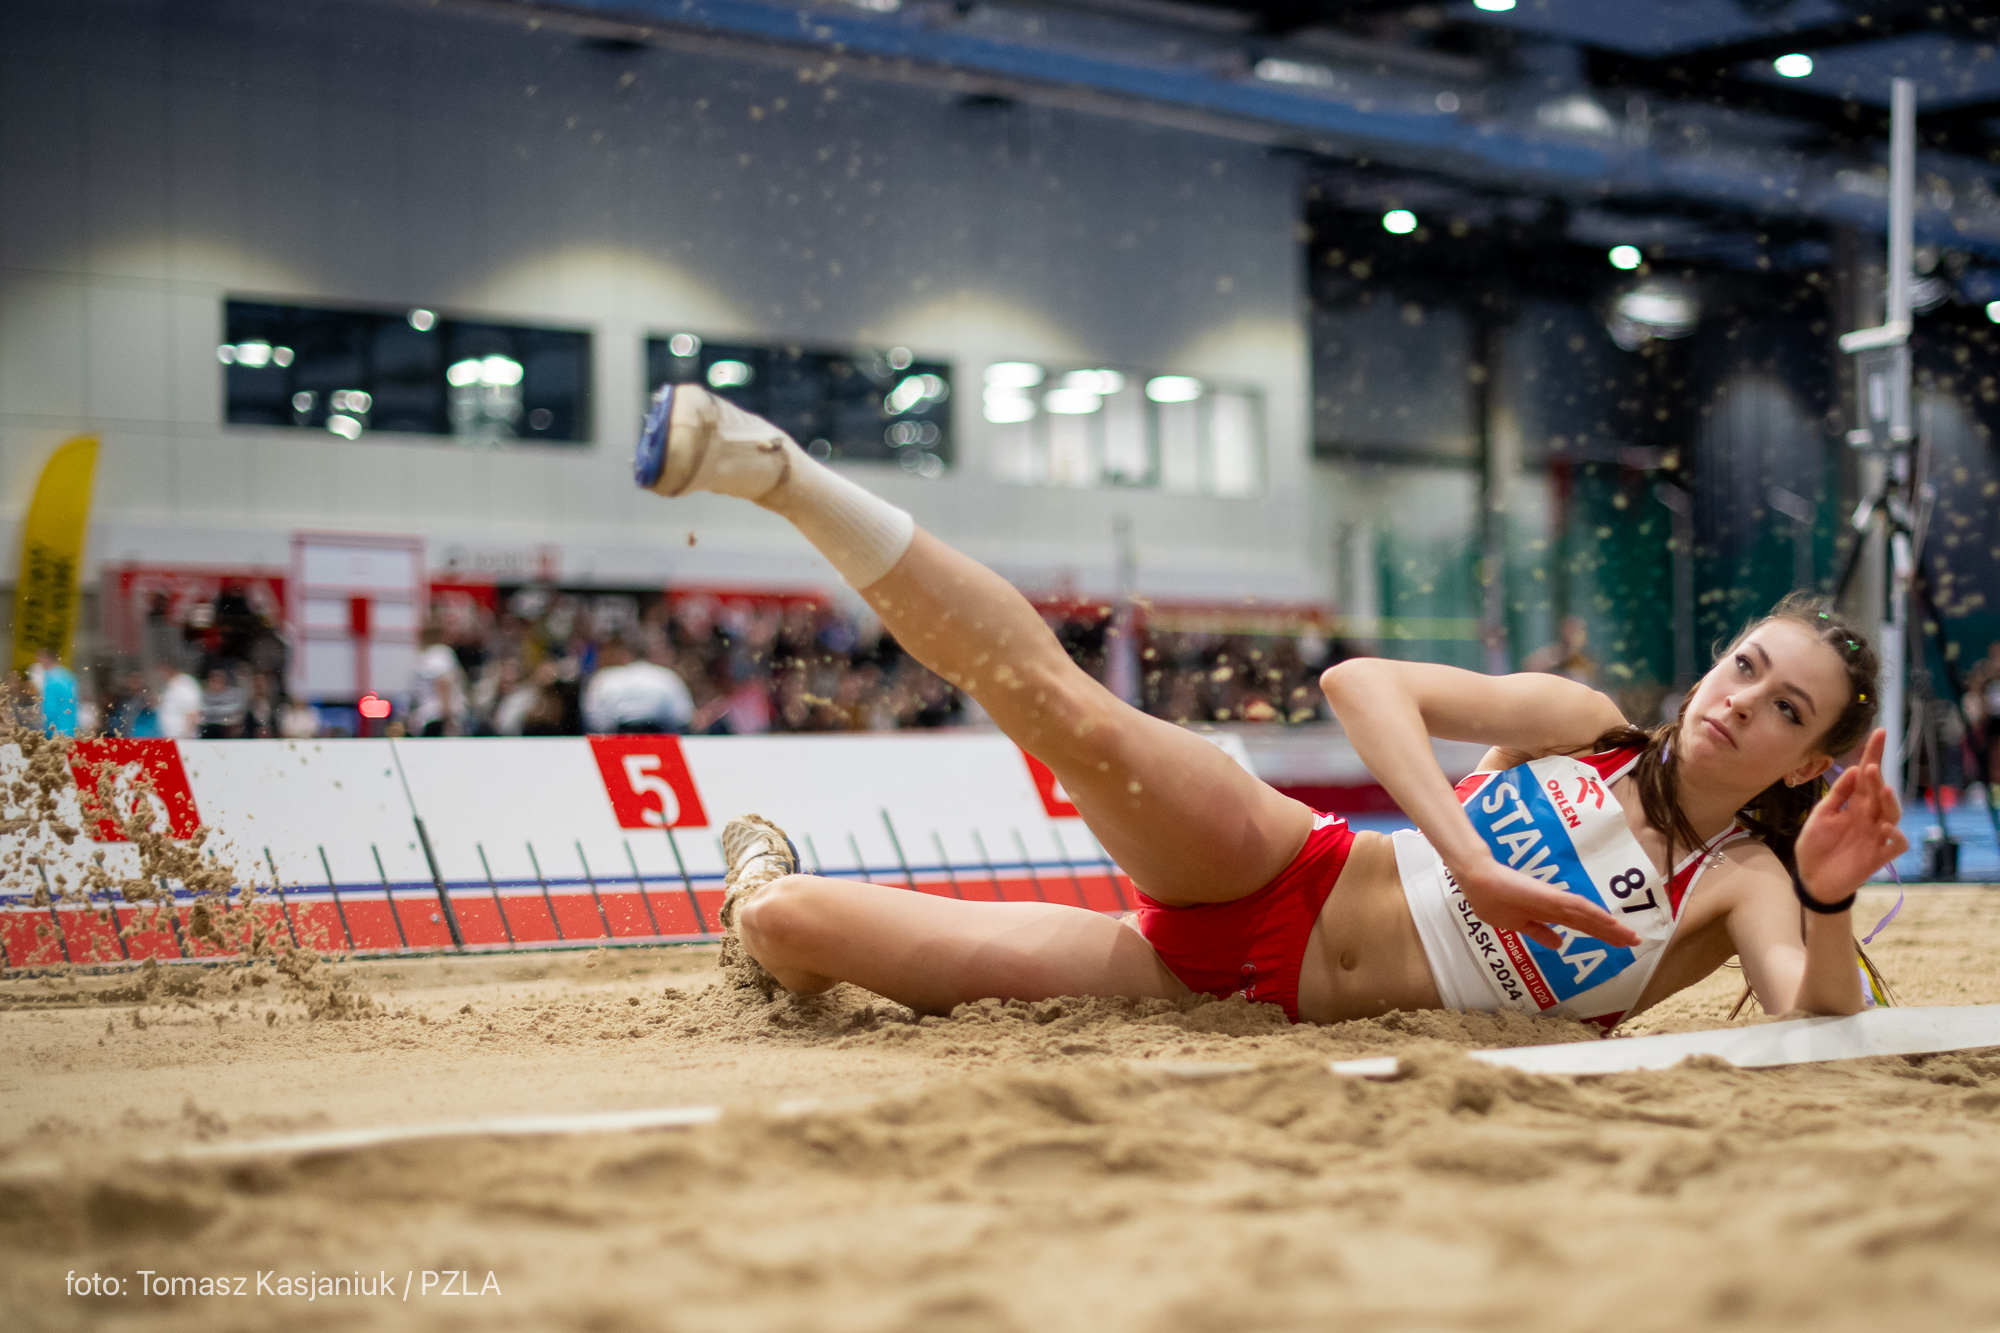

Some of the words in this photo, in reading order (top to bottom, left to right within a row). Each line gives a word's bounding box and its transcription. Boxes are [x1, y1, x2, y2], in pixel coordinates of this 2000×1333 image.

[621, 753, 681, 828] 5
[1546, 779, 1582, 829] ORLEN
[1482, 781, 1608, 985] STAWKA
[1609, 867, 1657, 914] 87
[1489, 958, 1523, 1001] 2024
[1503, 933, 1525, 965] Polski
[1520, 962, 1536, 982] U18
[1533, 985, 1550, 1004] U20
